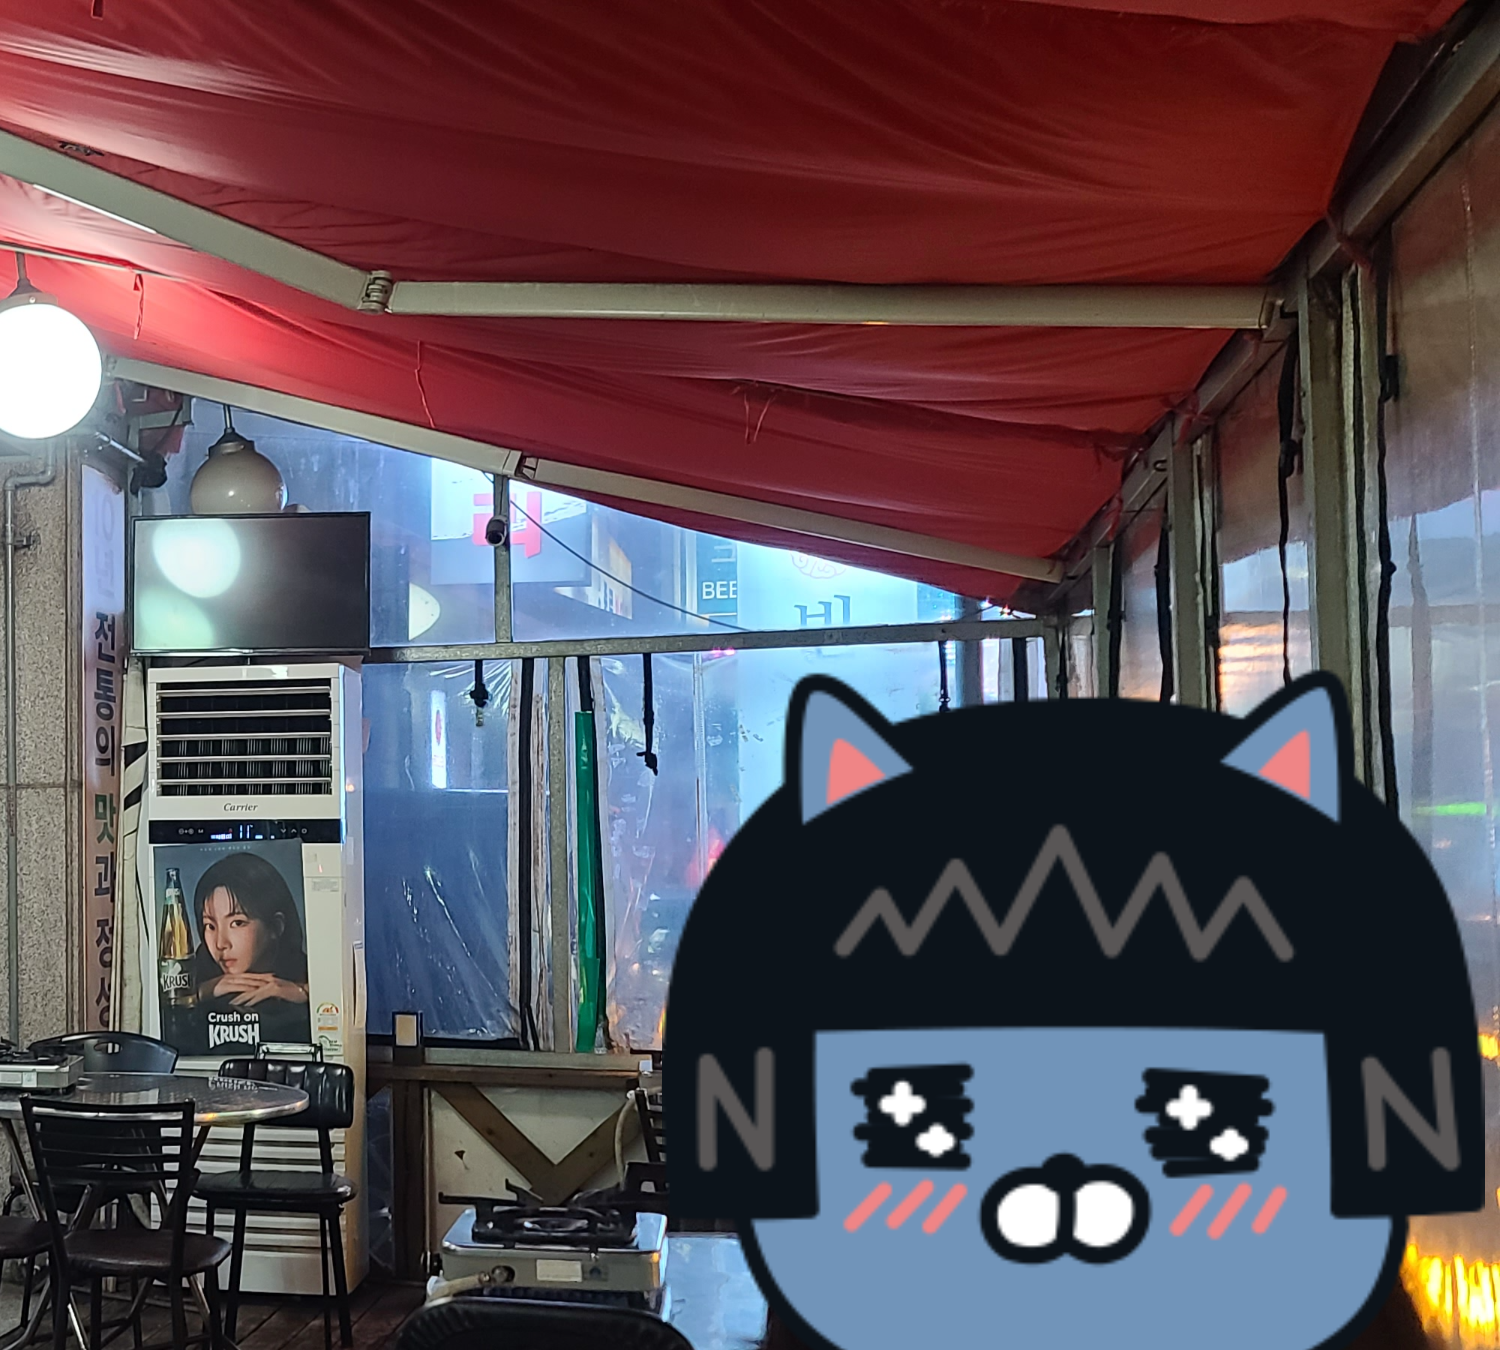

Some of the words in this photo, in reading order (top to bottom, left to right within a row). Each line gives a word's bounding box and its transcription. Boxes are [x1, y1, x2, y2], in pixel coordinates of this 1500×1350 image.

[94, 611, 116, 776] 전통의
[223, 802, 258, 812] Carrier
[208, 1012, 240, 1022] Crush
[243, 1013, 259, 1022] on
[208, 1023, 260, 1048] KRUSH
